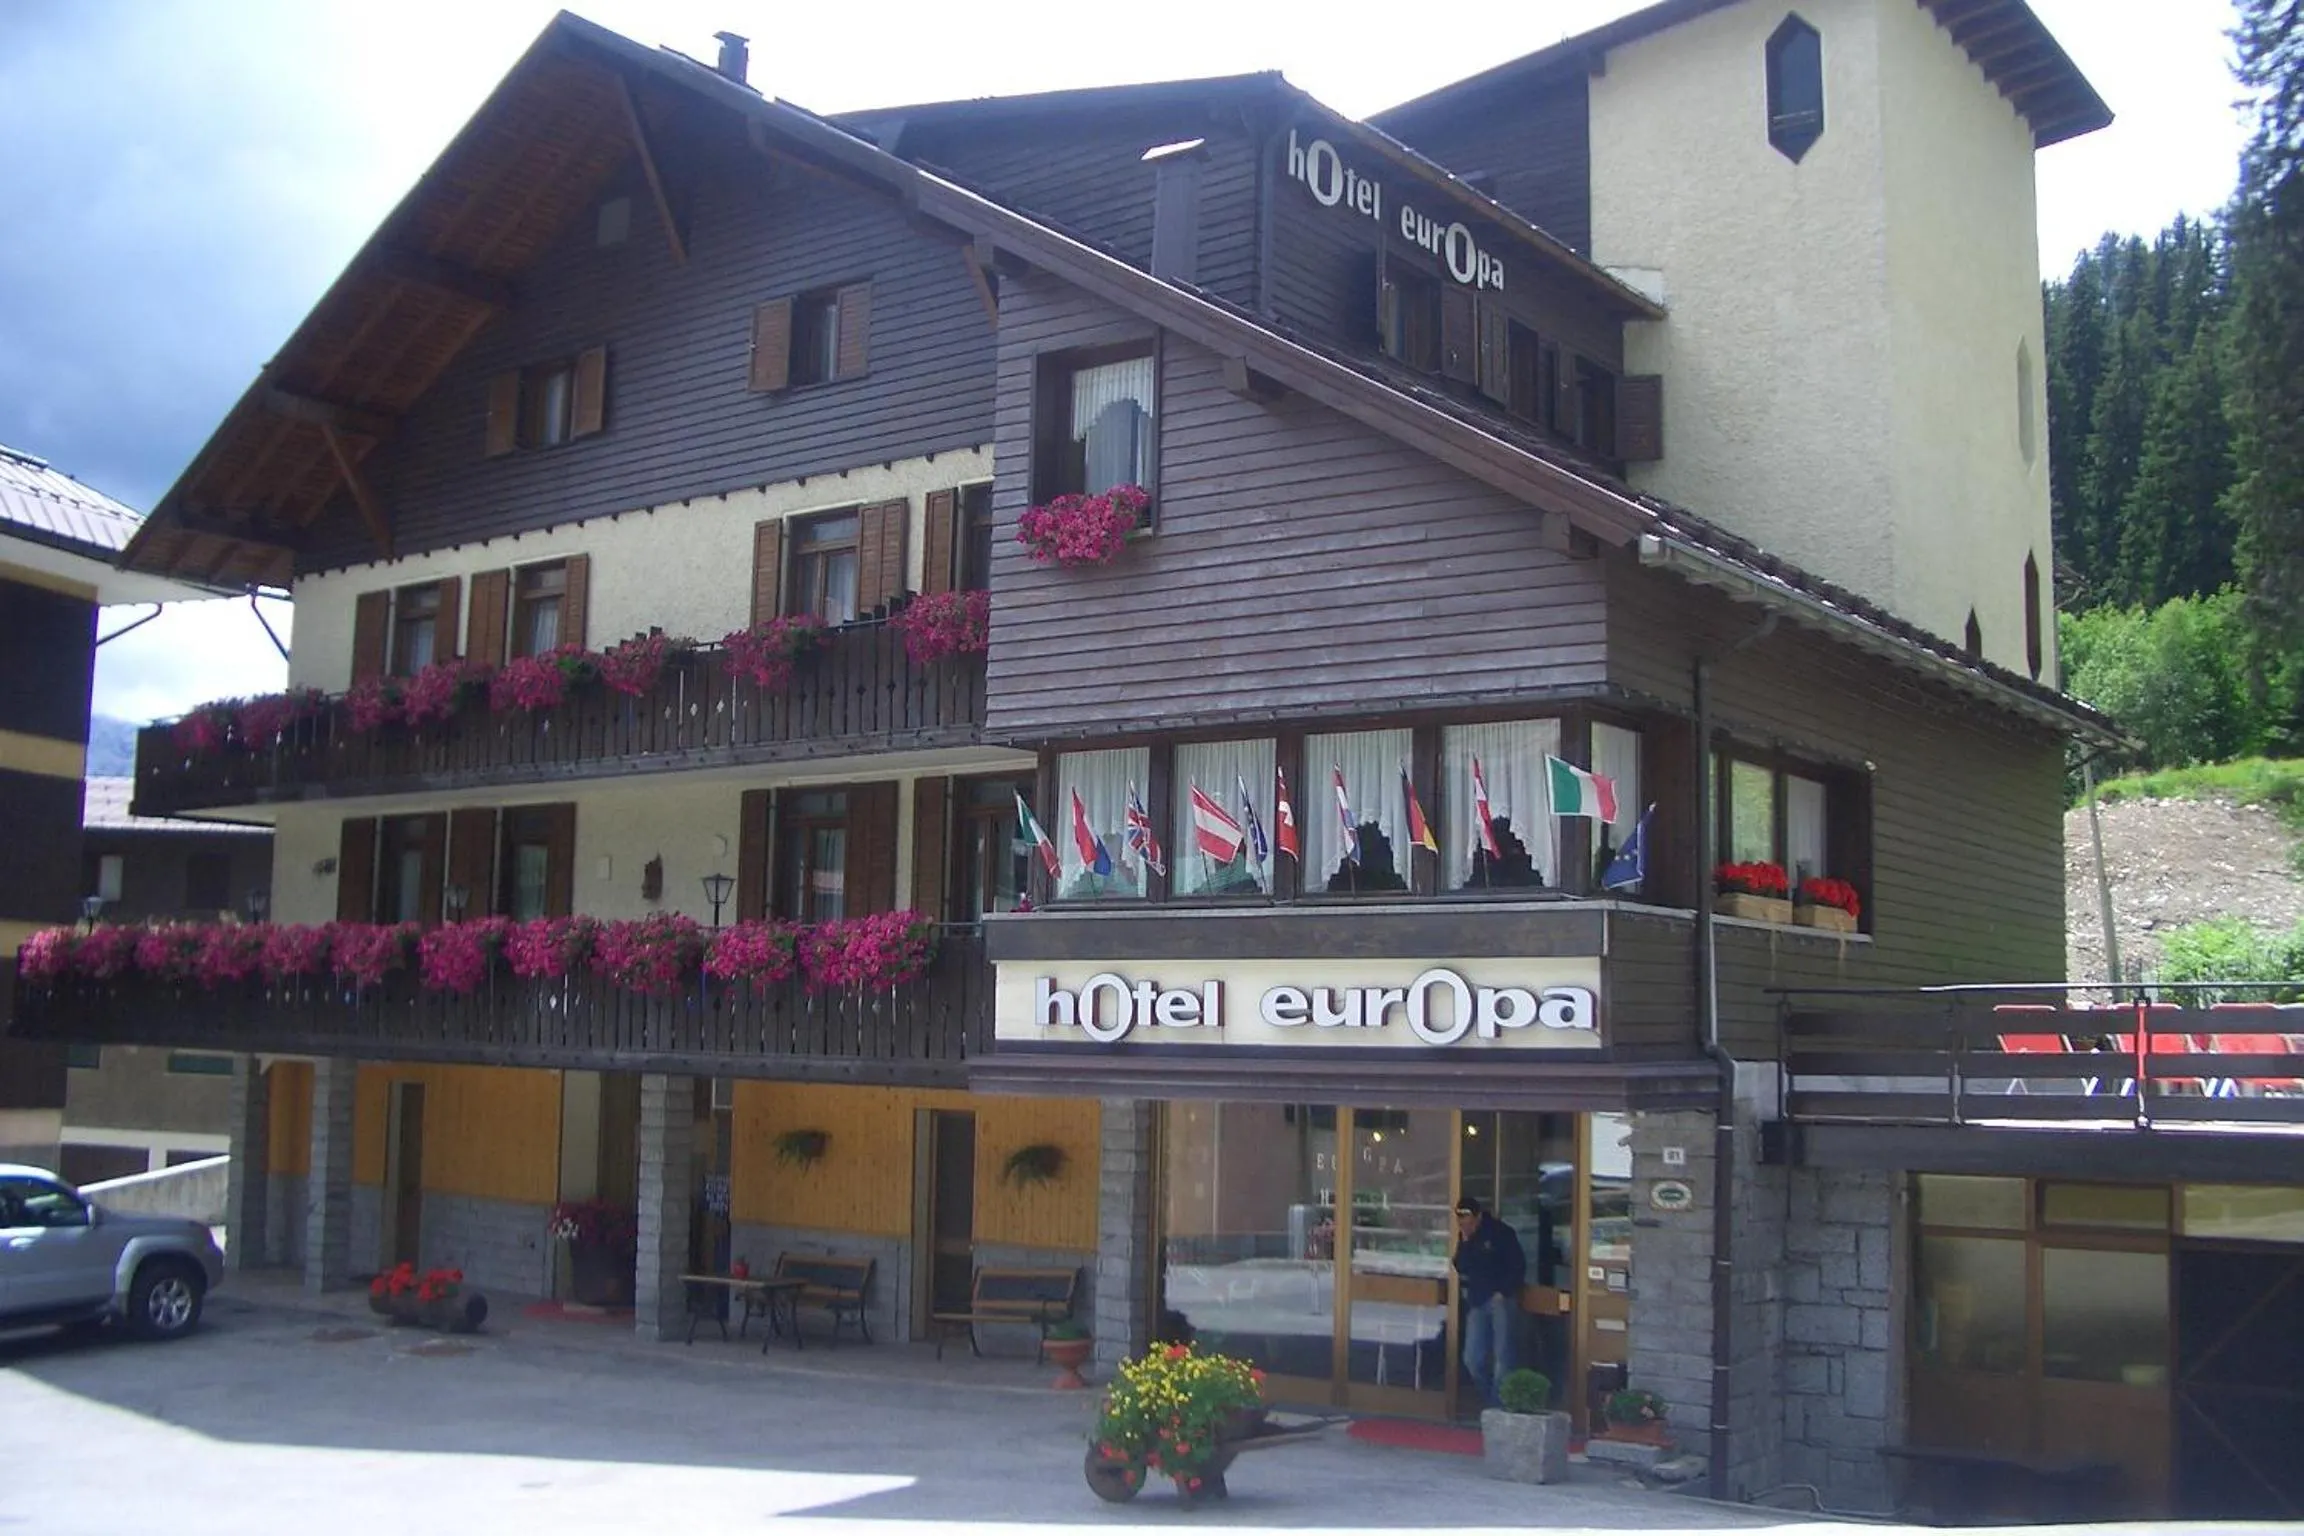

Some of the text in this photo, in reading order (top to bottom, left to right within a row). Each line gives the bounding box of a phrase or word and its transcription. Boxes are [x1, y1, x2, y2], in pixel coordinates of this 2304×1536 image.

[1287, 127, 1505, 291] hOtel eurOpa
[1034, 967, 1597, 1045] hOtel eurOpa
